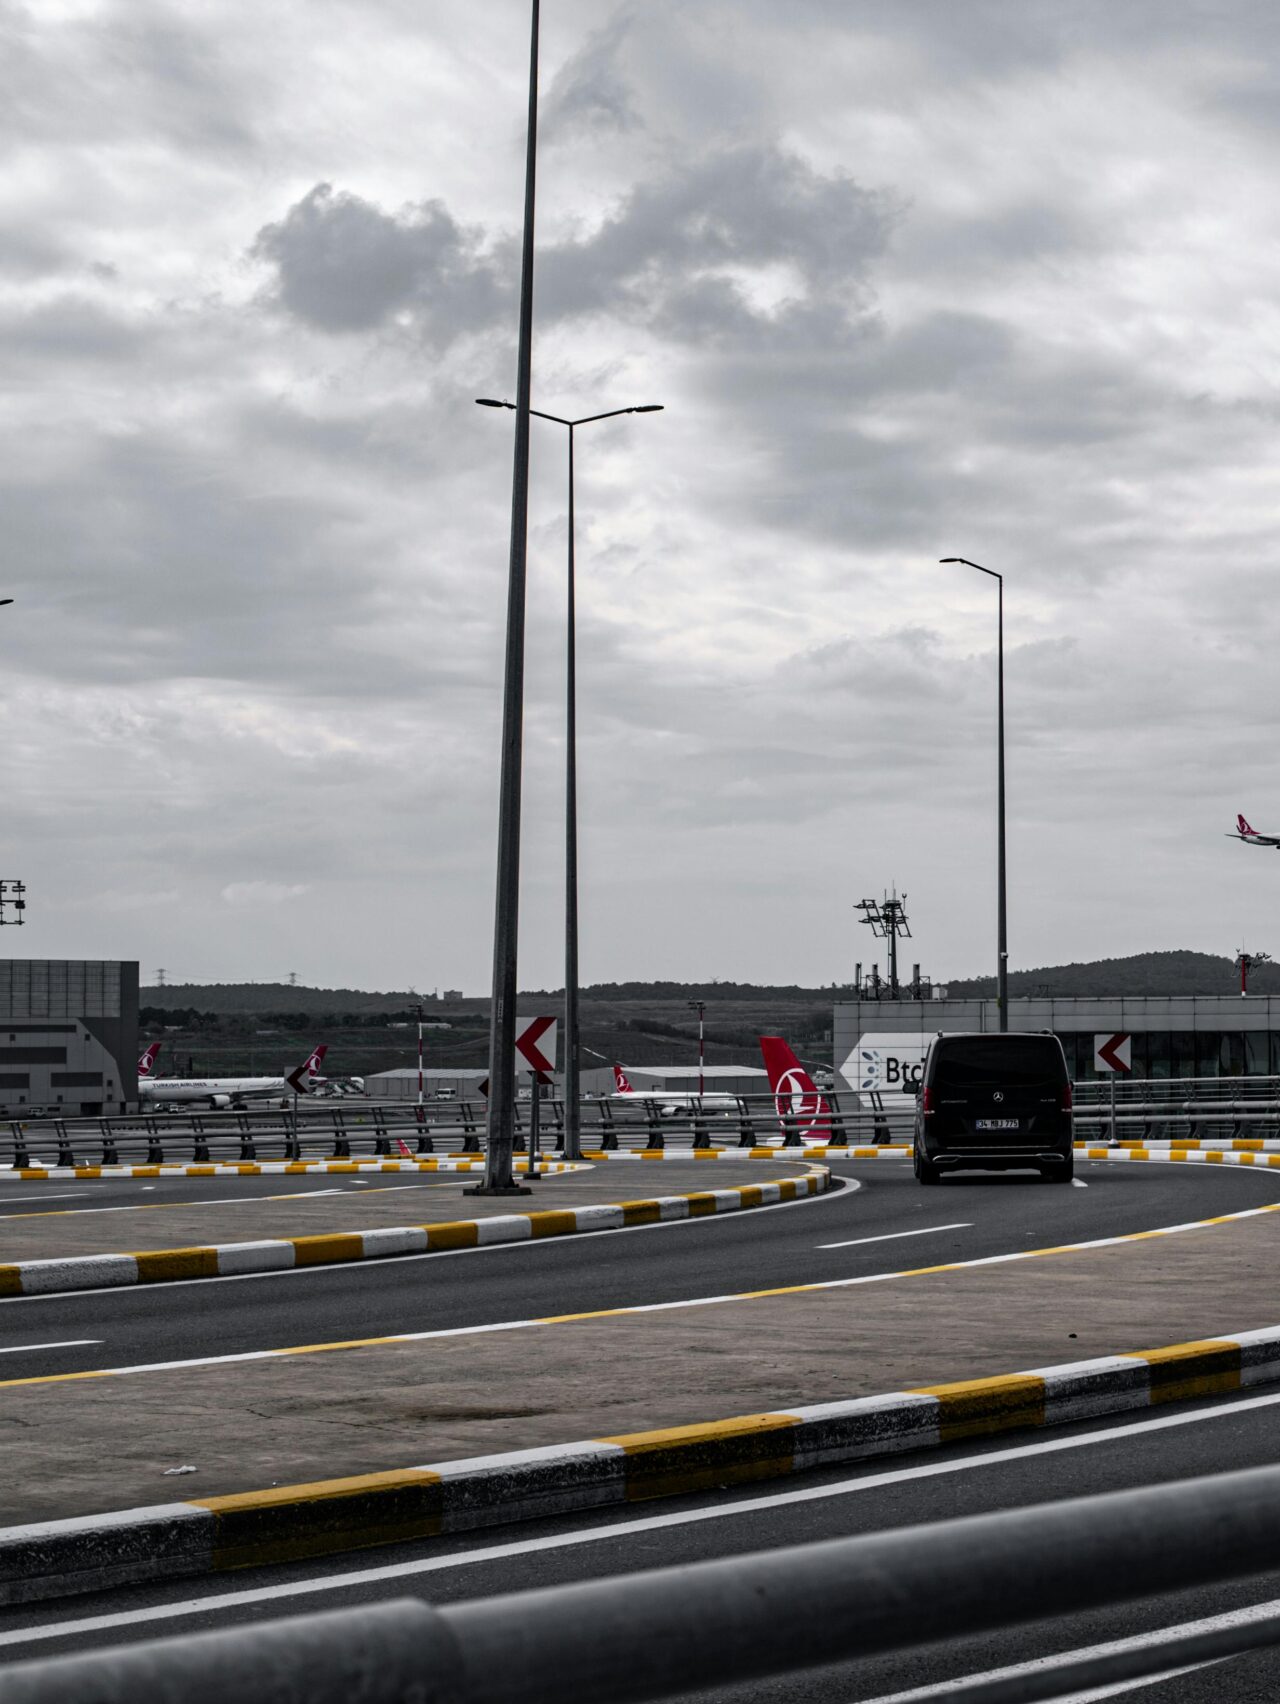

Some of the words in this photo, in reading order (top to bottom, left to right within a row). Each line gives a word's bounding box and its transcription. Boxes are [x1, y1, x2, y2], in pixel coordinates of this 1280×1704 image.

[887, 1058, 926, 1083] Btc
[979, 1120, 988, 1128] 34
[1006, 1119, 1018, 1127] 775
